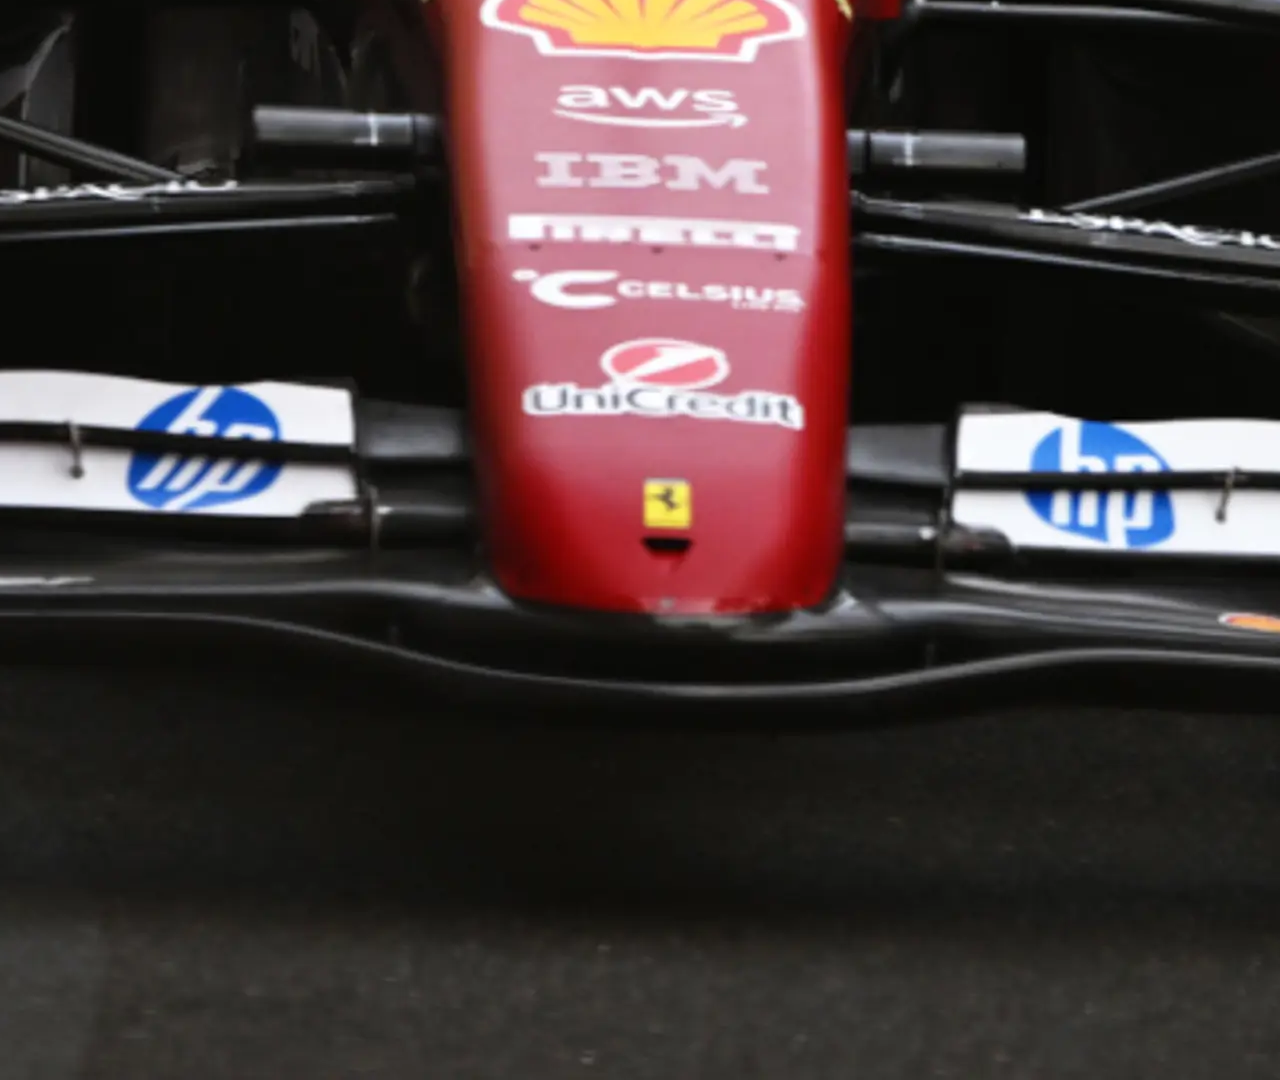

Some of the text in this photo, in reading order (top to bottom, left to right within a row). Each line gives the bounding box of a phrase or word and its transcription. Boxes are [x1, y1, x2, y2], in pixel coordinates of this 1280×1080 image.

[558, 84, 738, 113] aws
[535, 152, 769, 195] IBM
[617, 279, 803, 306] CELSIUS
[531, 382, 800, 426] UniCredit
